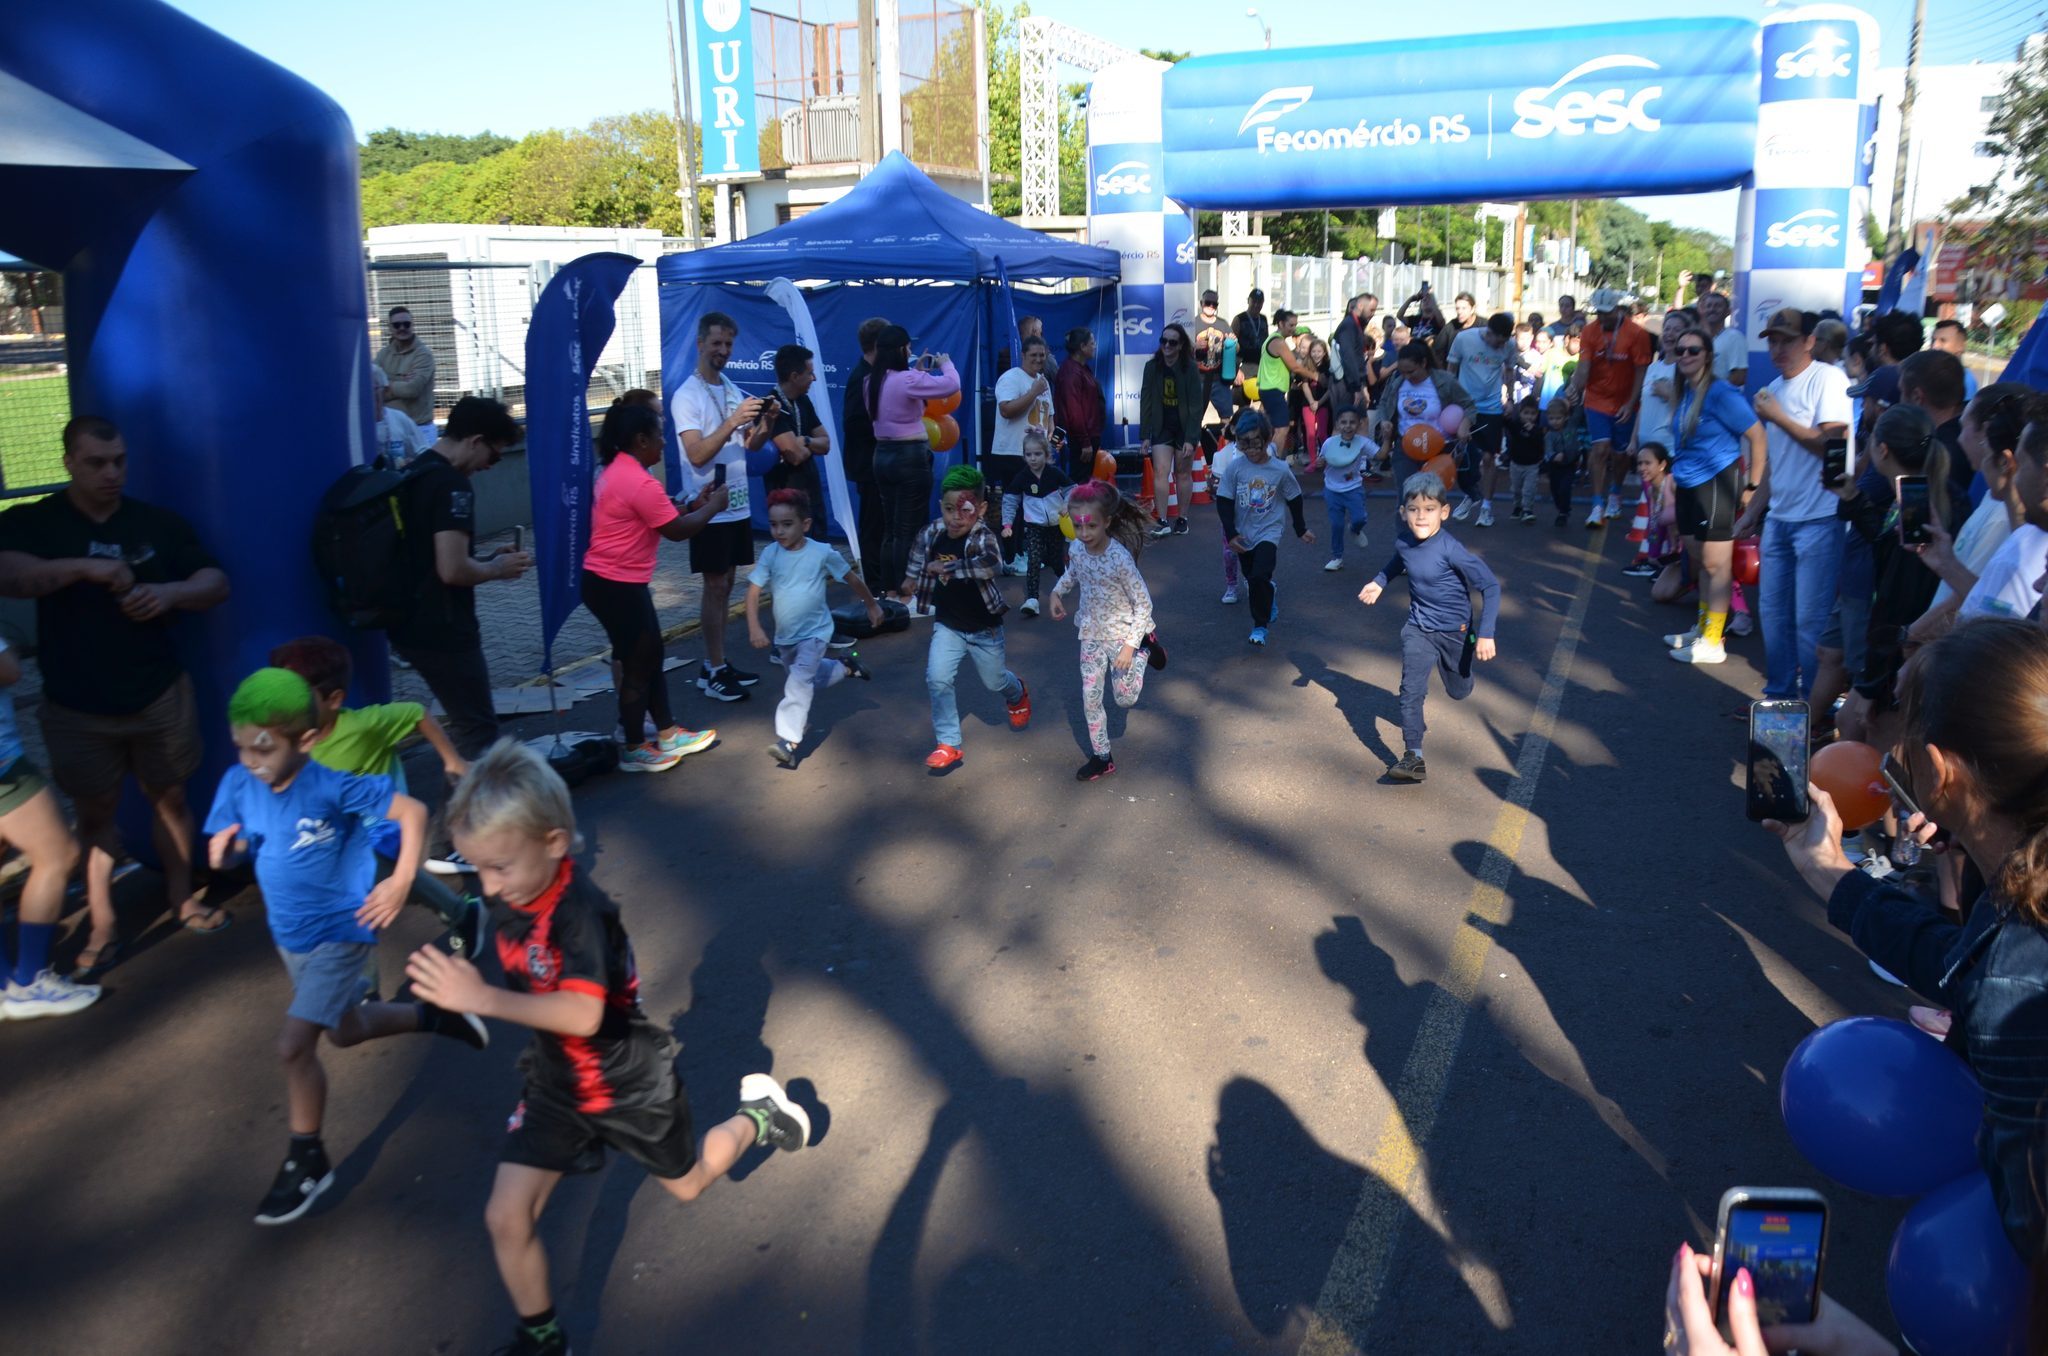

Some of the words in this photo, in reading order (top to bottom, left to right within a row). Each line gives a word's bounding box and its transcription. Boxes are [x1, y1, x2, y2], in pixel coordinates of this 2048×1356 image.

[708, 40, 745, 171] URI
[1510, 85, 1663, 139] Sesc
[1257, 117, 1420, 154] Fecomércio
[1429, 113, 1470, 143] RS
[1121, 250, 1144, 259] ércio
[1114, 317, 1153, 336] esc
[725, 358, 760, 370] mércio
[761, 360, 775, 371] RS
[570, 395, 581, 466] Sindicatos
